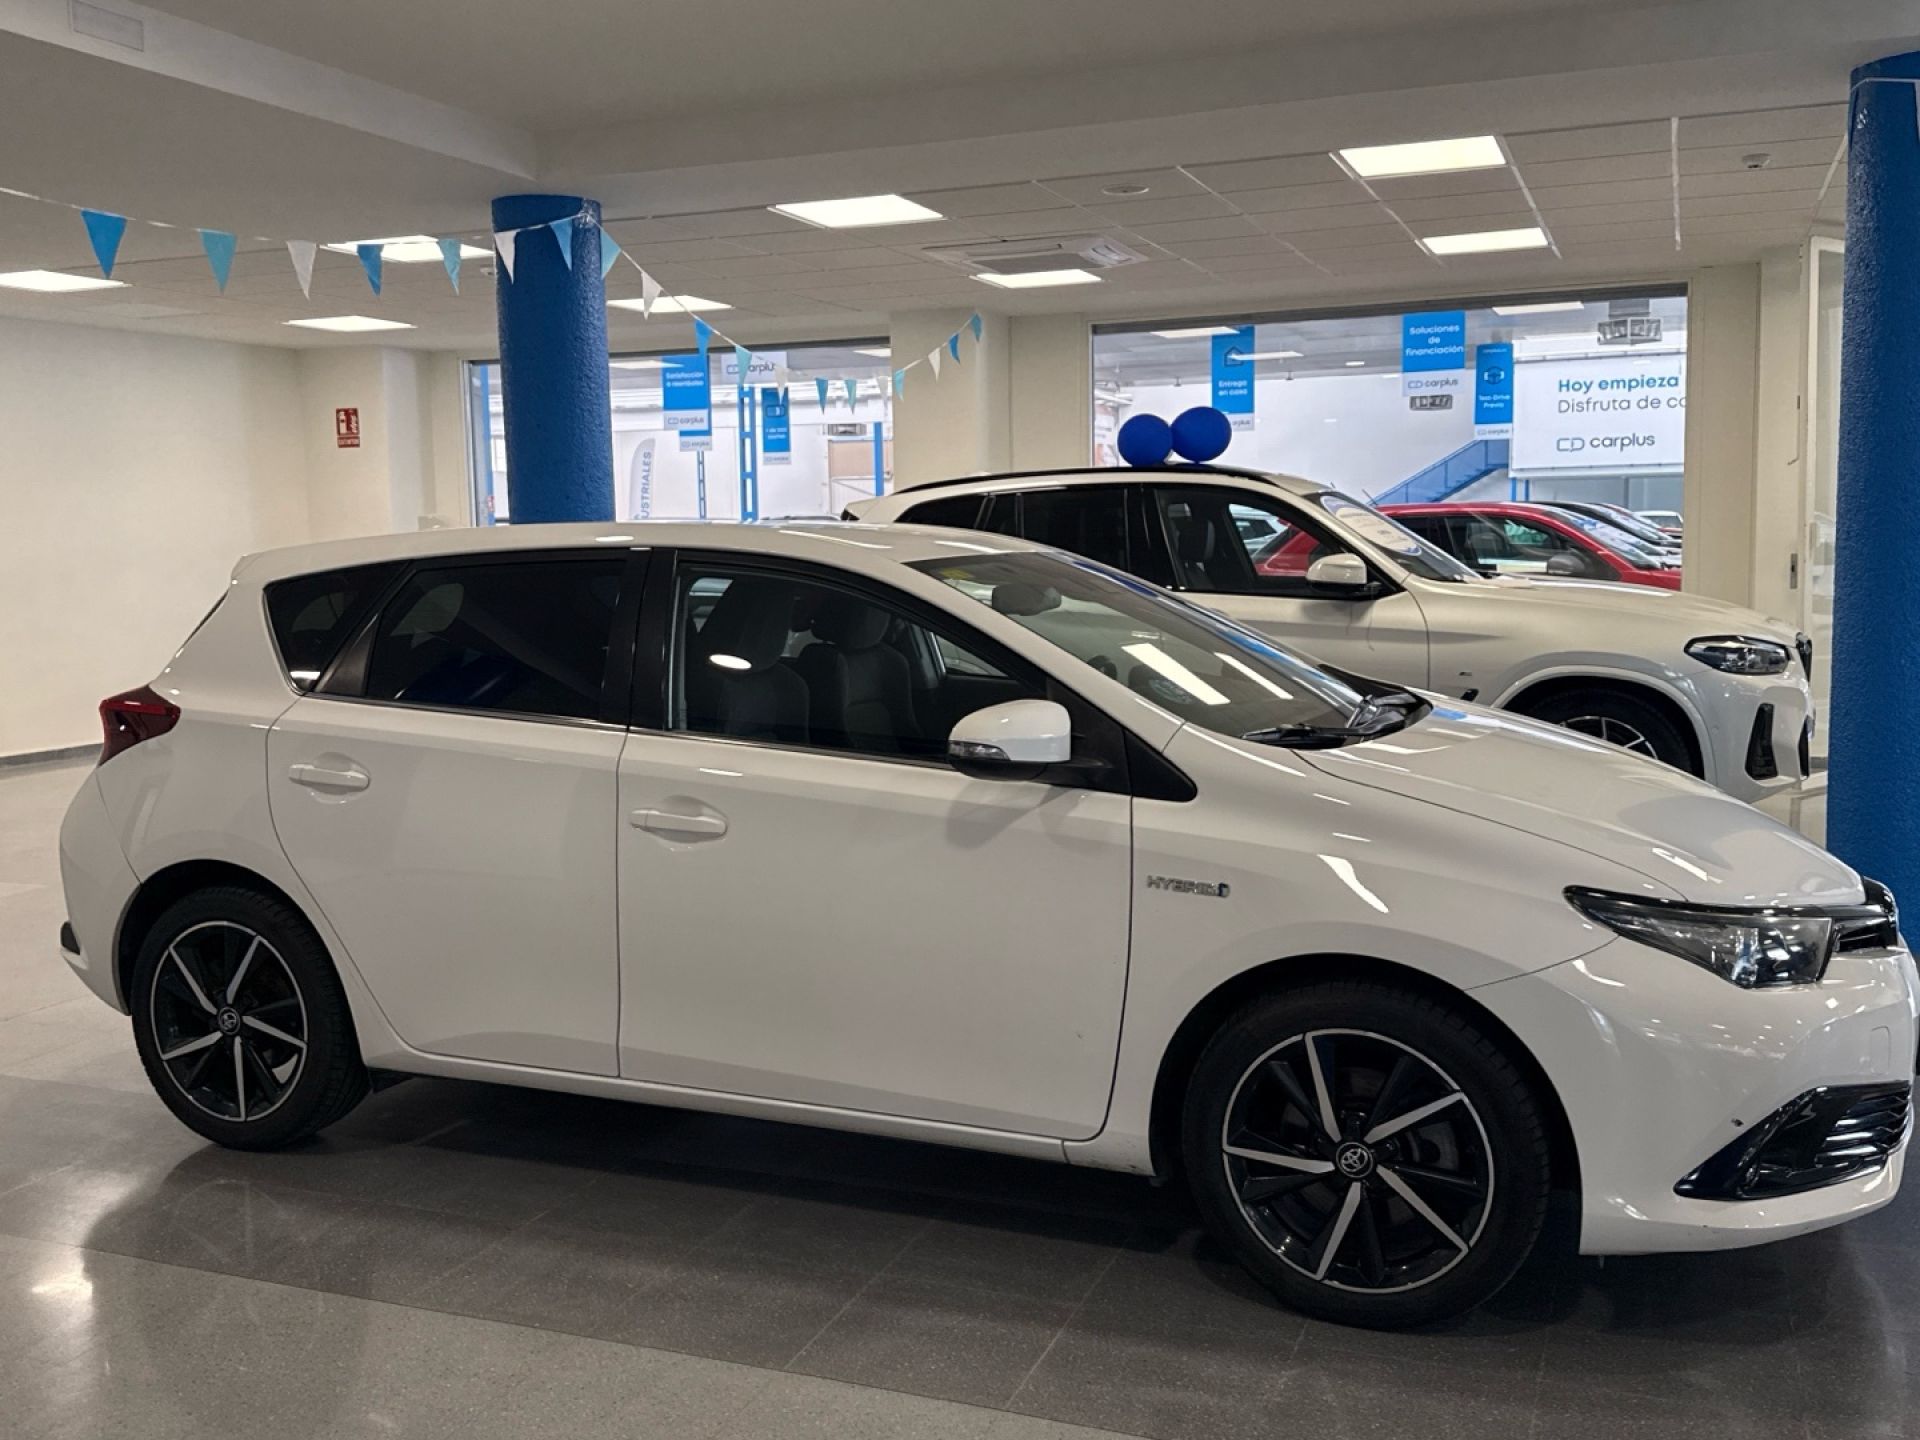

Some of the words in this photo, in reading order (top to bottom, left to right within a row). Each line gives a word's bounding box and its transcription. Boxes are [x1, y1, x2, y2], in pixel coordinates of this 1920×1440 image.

[1409, 325, 1460, 335] Soluciones
[1428, 336, 1441, 344] de
[1405, 345, 1465, 356] financiación
[748, 362, 776, 375] arplu
[1218, 380, 1248, 388] Entrega
[1425, 378, 1459, 388] carplus
[1558, 377, 1593, 394] Hoy
[1598, 374, 1679, 392] empieza
[1558, 396, 1631, 413] Disfruta
[1636, 395, 1661, 409] de
[1589, 432, 1656, 452] carplus
